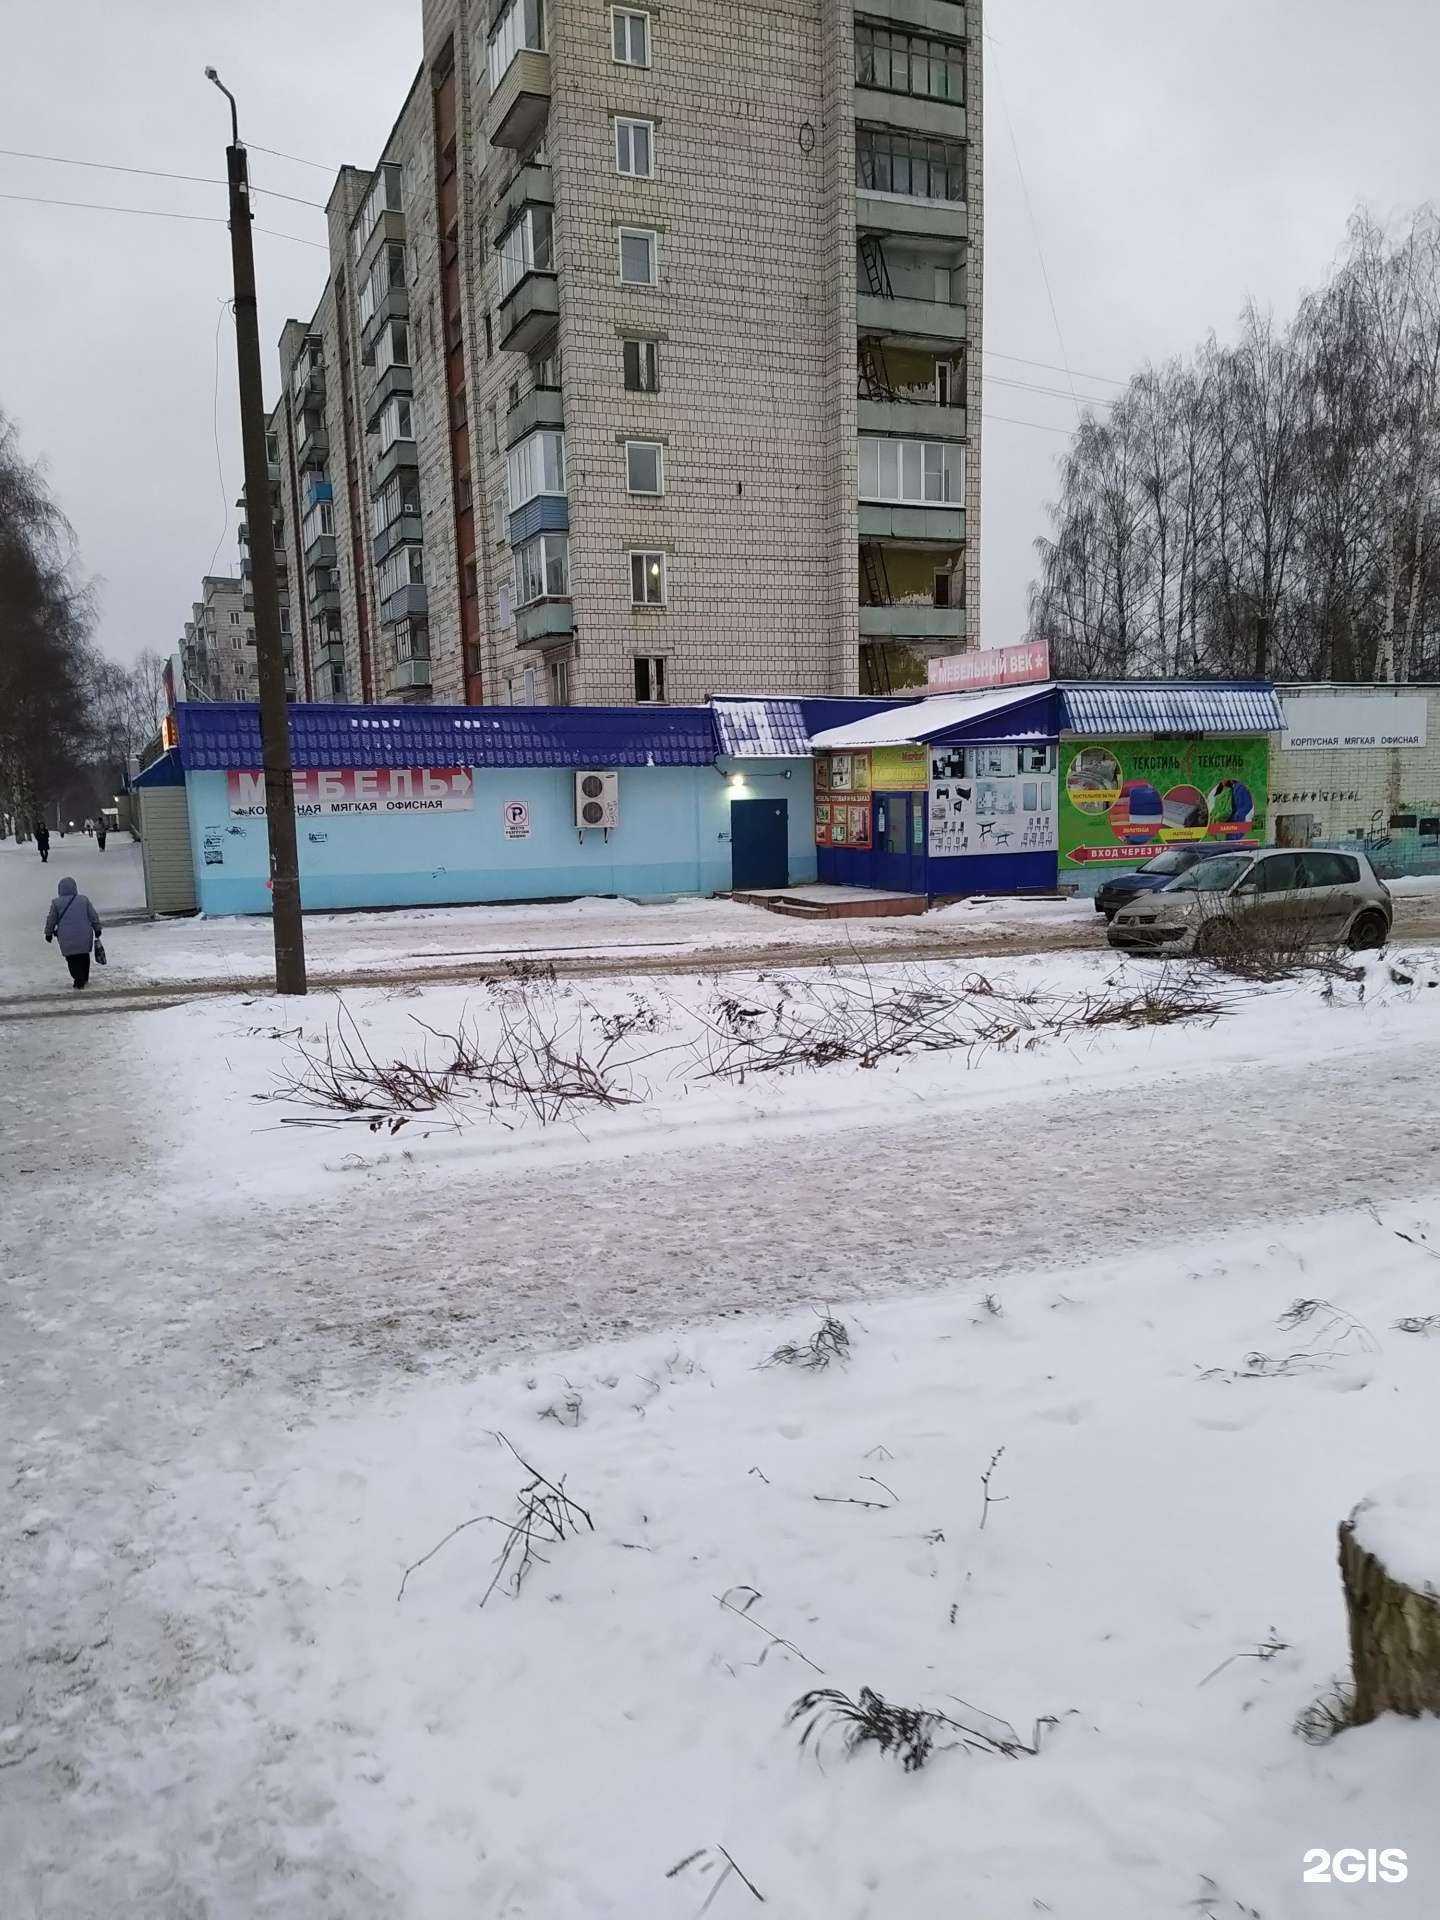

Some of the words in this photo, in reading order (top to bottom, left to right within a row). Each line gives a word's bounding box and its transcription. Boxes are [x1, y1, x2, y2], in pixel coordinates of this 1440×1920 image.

[938, 654, 1007, 683] МЕБЕЛЬНЫЙ
[1010, 654, 1033, 672] ВЕК
[1290, 737, 1339, 746] КОРПУСНАЯ
[1344, 736, 1376, 745] МЯГКАЯ
[1380, 735, 1419, 745] ОФИСНАЯ
[1132, 756, 1180, 769] ТЕКСТИЛЬ
[1198, 754, 1244, 768] ТЕКСТИЛЬ
[239, 769, 449, 801] МЕБЕЛЬ
[331, 802, 377, 812] МЯГКАЯ
[386, 800, 443, 810] ОФИСНАЯ
[1091, 848, 1120, 858] ВХОД
[1121, 847, 1152, 857] ЧЕРЕЗ
